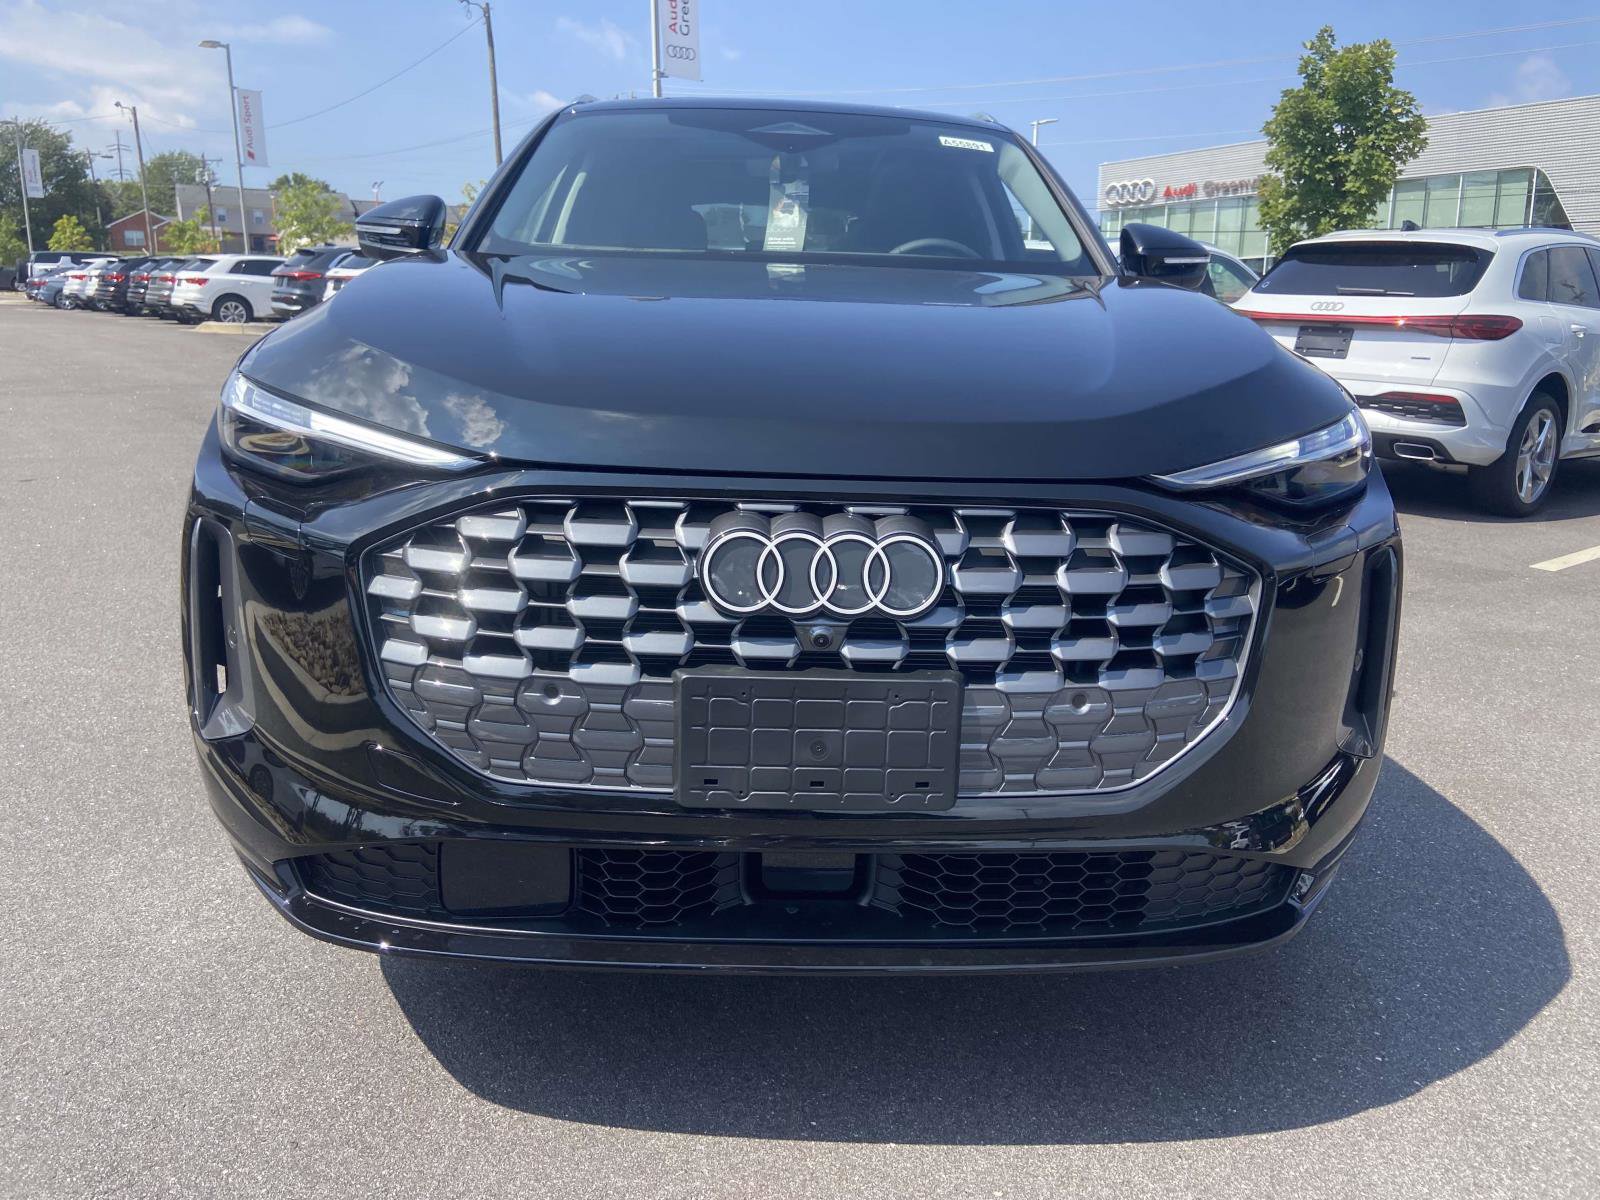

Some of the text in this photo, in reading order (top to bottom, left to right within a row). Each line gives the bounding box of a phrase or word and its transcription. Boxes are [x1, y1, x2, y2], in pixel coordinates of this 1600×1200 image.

[243, 95, 254, 149] Audi Sport
[1163, 182, 1198, 198] Audi
